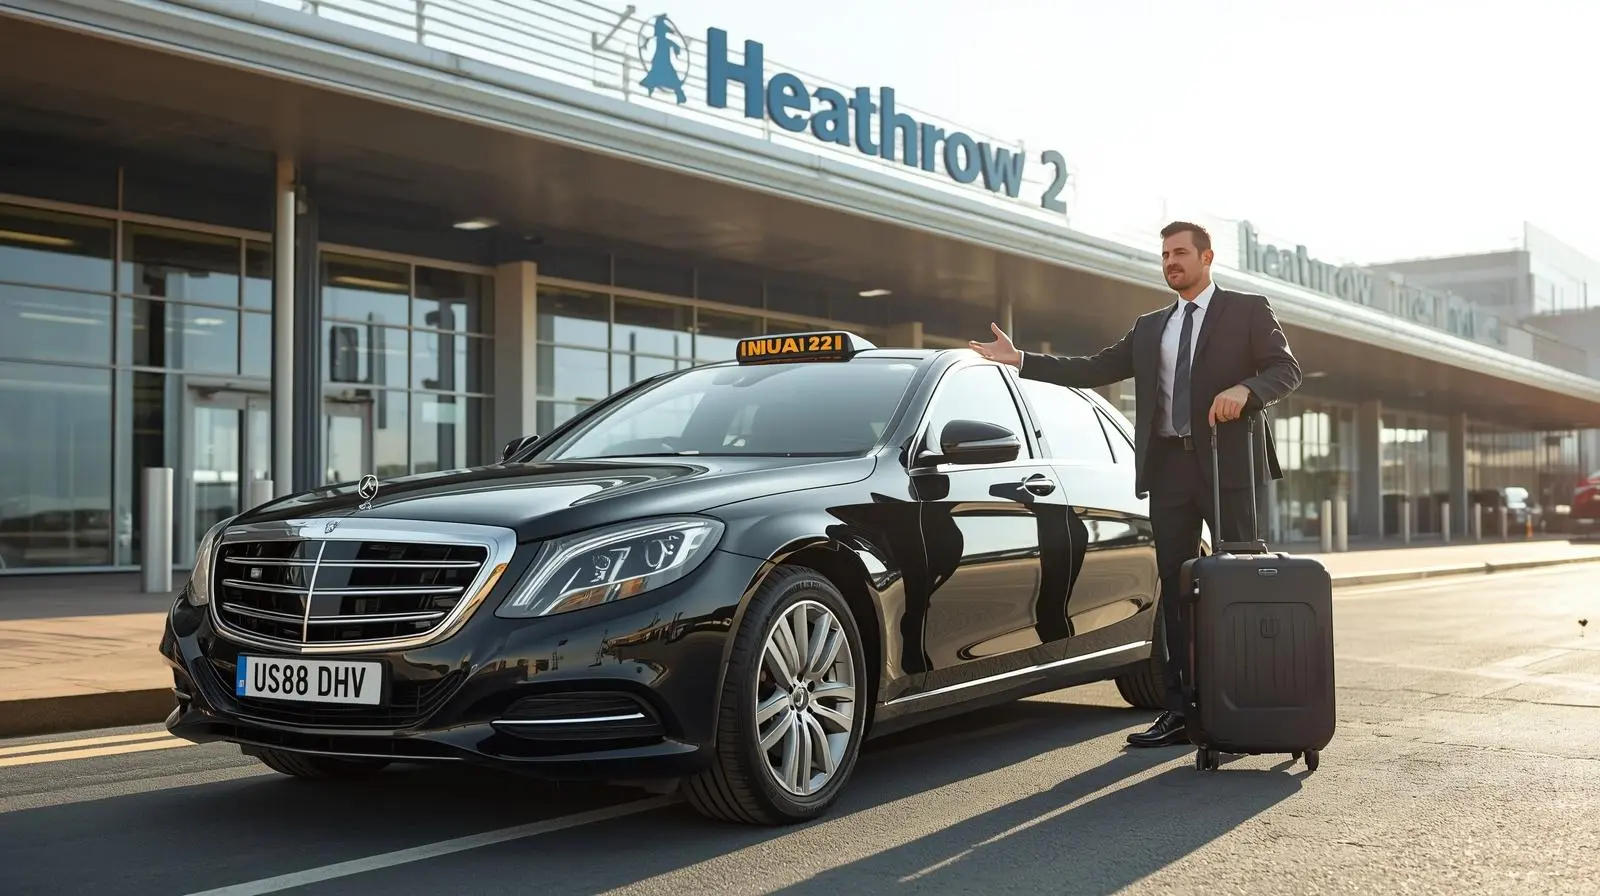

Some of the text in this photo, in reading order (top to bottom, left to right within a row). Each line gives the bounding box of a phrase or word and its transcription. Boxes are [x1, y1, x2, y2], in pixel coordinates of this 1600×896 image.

[707, 26, 1068, 214] Heathrow 2
[254, 662, 367, 698] US88 DHV
